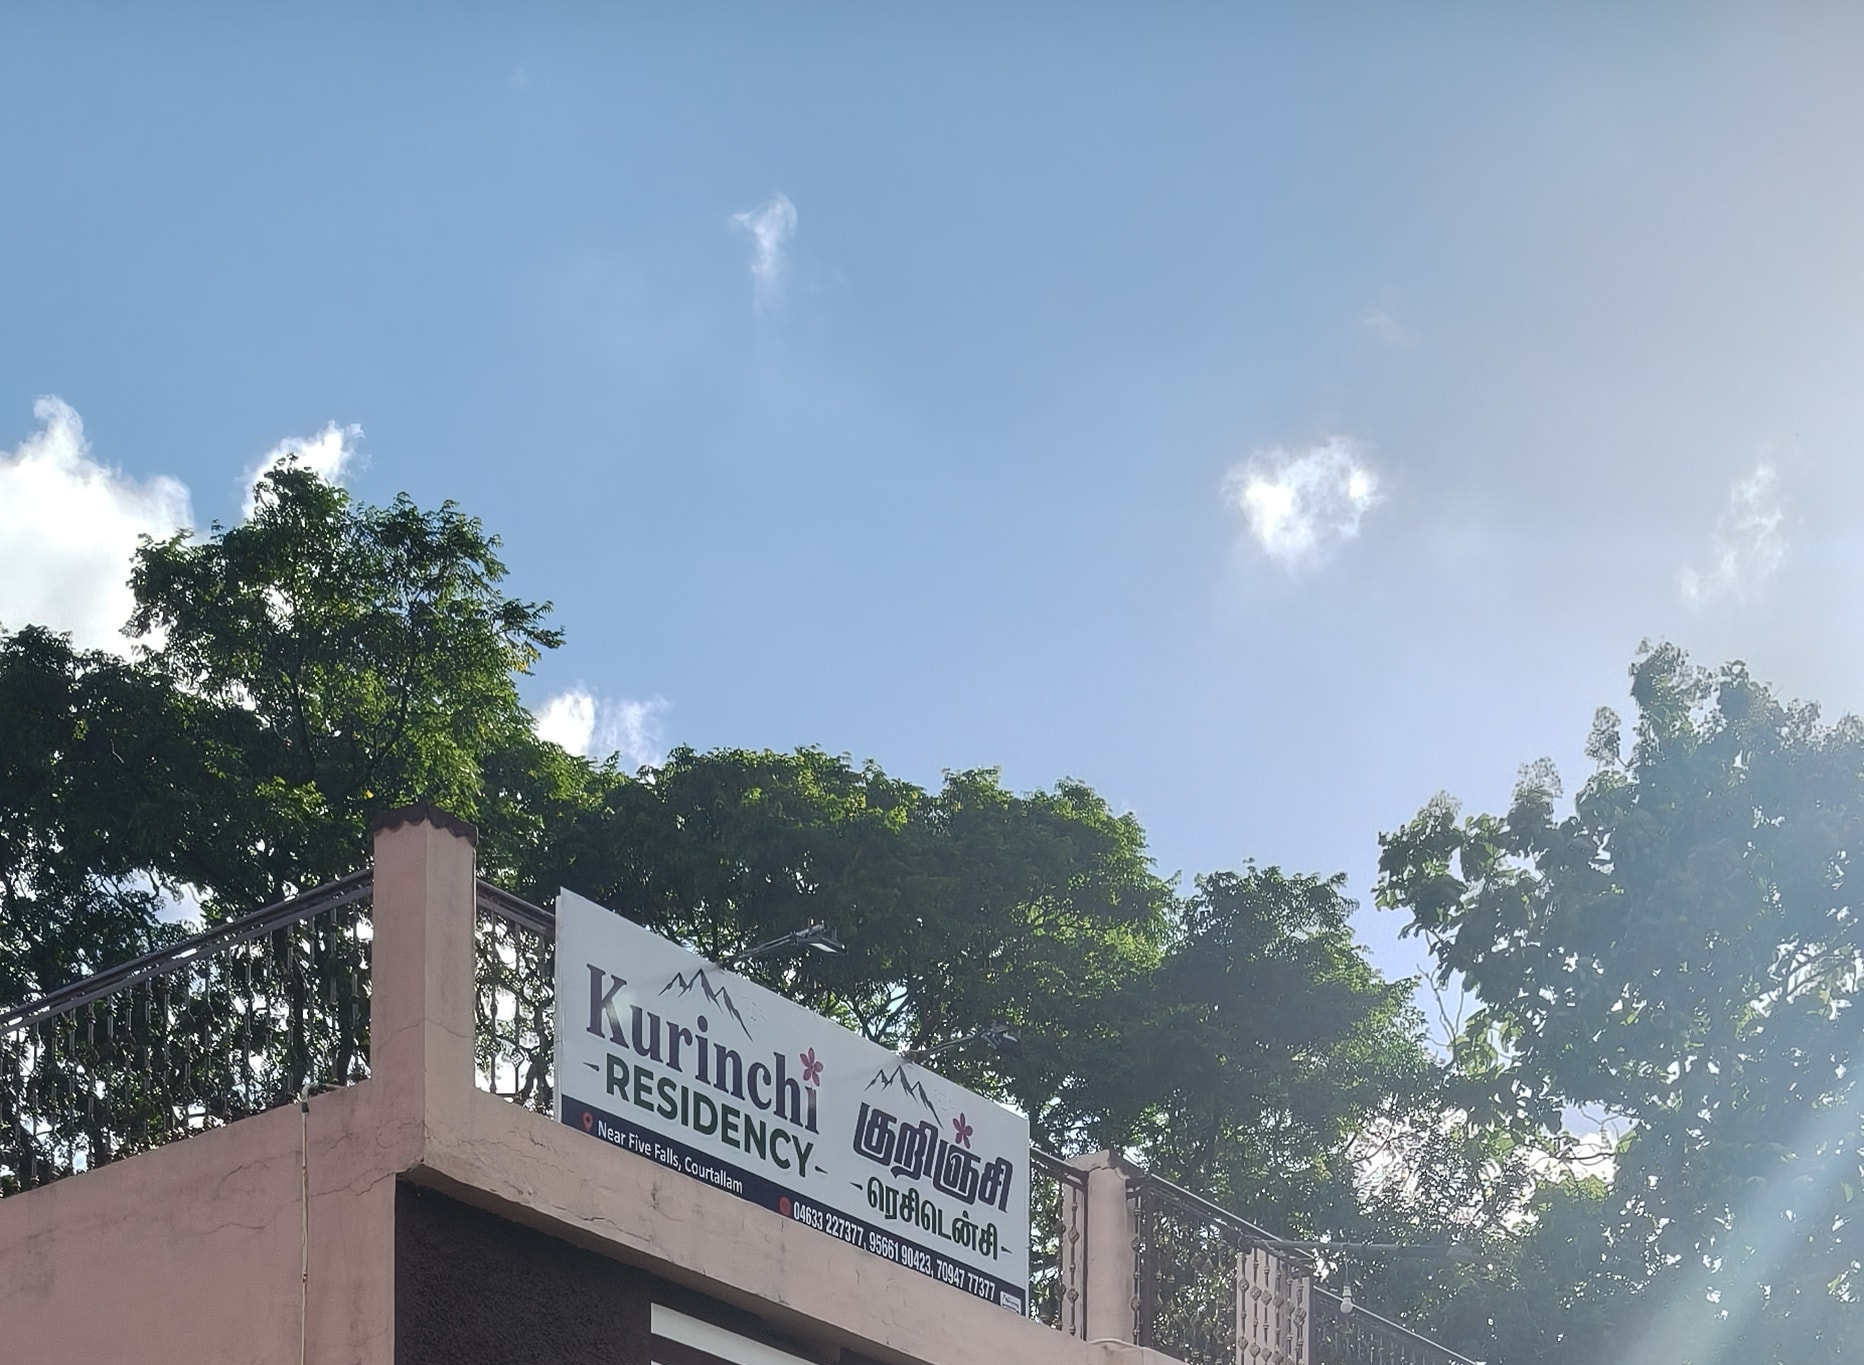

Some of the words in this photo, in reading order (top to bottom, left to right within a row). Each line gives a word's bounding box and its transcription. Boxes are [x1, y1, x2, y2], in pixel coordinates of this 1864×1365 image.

[586, 963, 820, 1135] Kurinchi
[598, 1120, 627, 1146] Near
[629, 1132, 651, 1156] Five
[654, 1143, 682, 1172] Falls,
[684, 1156, 743, 1194] Courtallam
[606, 1052, 814, 1179] RESIDENCY
[793, 1201, 824, 1231] 04633
[825, 1212, 867, 1252] 227377,
[869, 1231, 899, 1262] 95661
[901, 1244, 934, 1279] 90423,
[936, 1259, 965, 1289] 70947
[967, 1271, 996, 1301] 77377
[867, 1176, 998, 1261] ரெசிடென்சி
